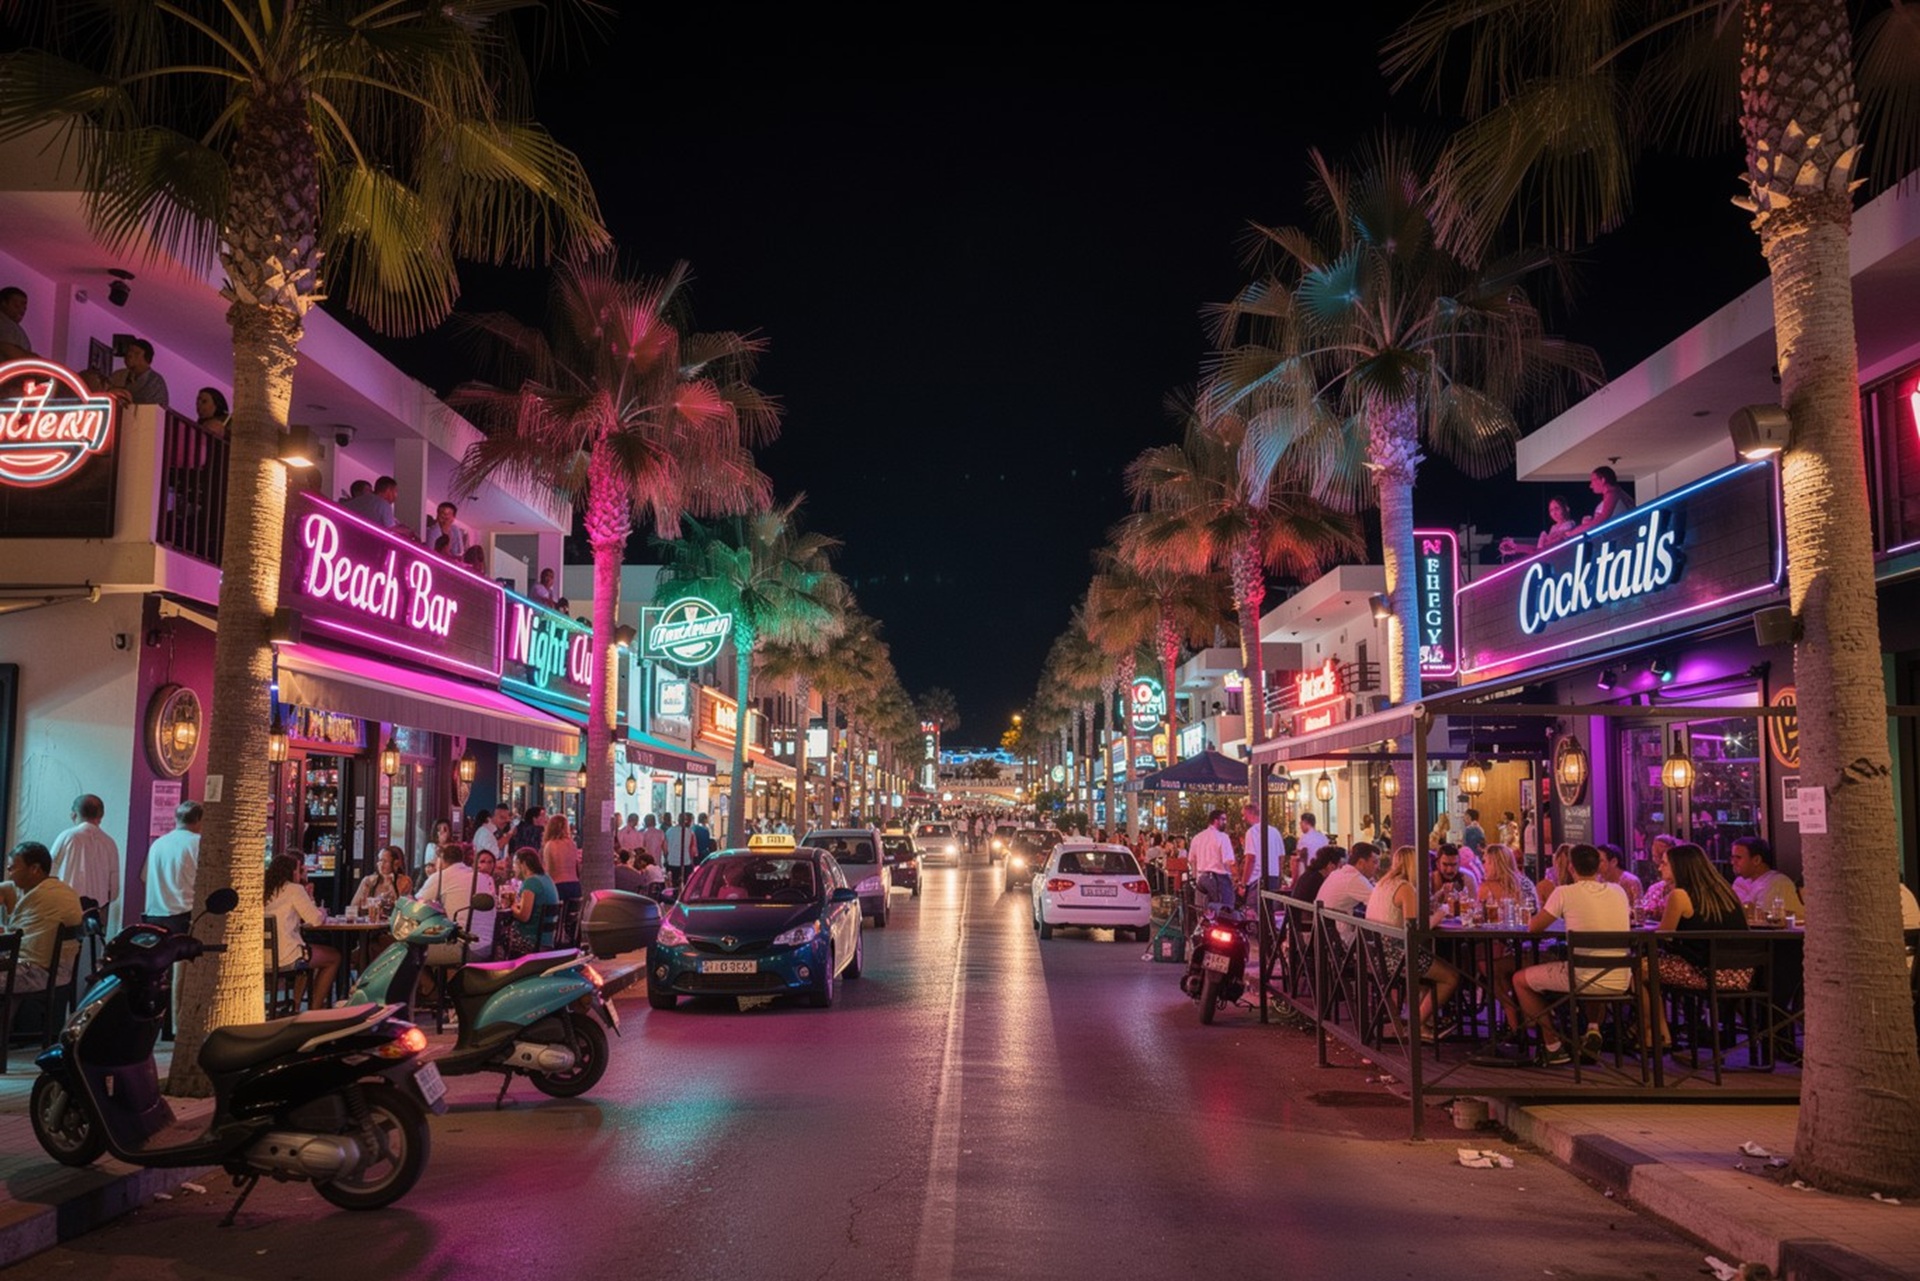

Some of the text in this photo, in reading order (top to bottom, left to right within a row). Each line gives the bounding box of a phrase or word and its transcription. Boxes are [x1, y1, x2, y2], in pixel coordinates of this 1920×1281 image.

[305, 514, 457, 636] Beach Bar
[1519, 510, 1675, 634] Cocktails
[511, 603, 569, 688] Night
